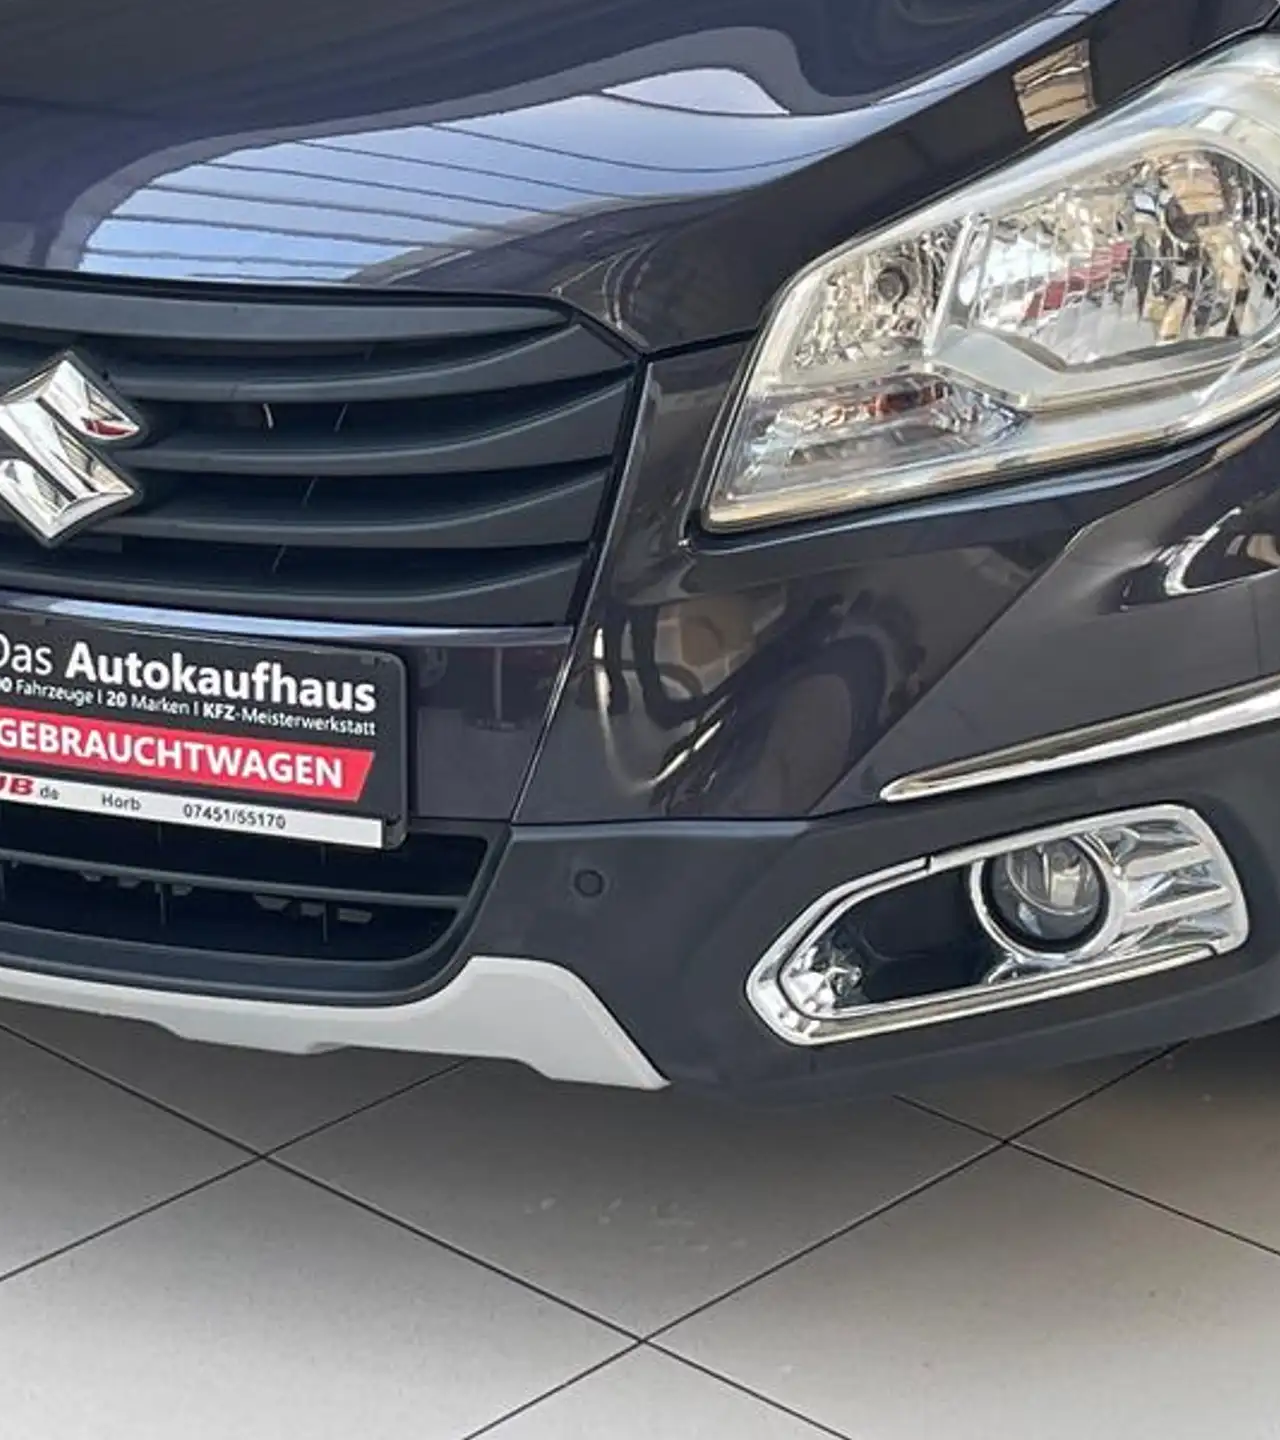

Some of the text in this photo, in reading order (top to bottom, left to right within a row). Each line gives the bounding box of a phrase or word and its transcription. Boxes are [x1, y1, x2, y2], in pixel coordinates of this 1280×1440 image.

[15, 677, 95, 708] Fahrzeuge
[106, 691, 128, 709] 20
[131, 693, 191, 716] Marken
[202, 701, 377, 737] KFZ-Meisterwerkstatt
[64, 640, 377, 715] Autokaufhaus
[101, 792, 143, 813] Horb
[182, 802, 287, 831] 07451/55170
